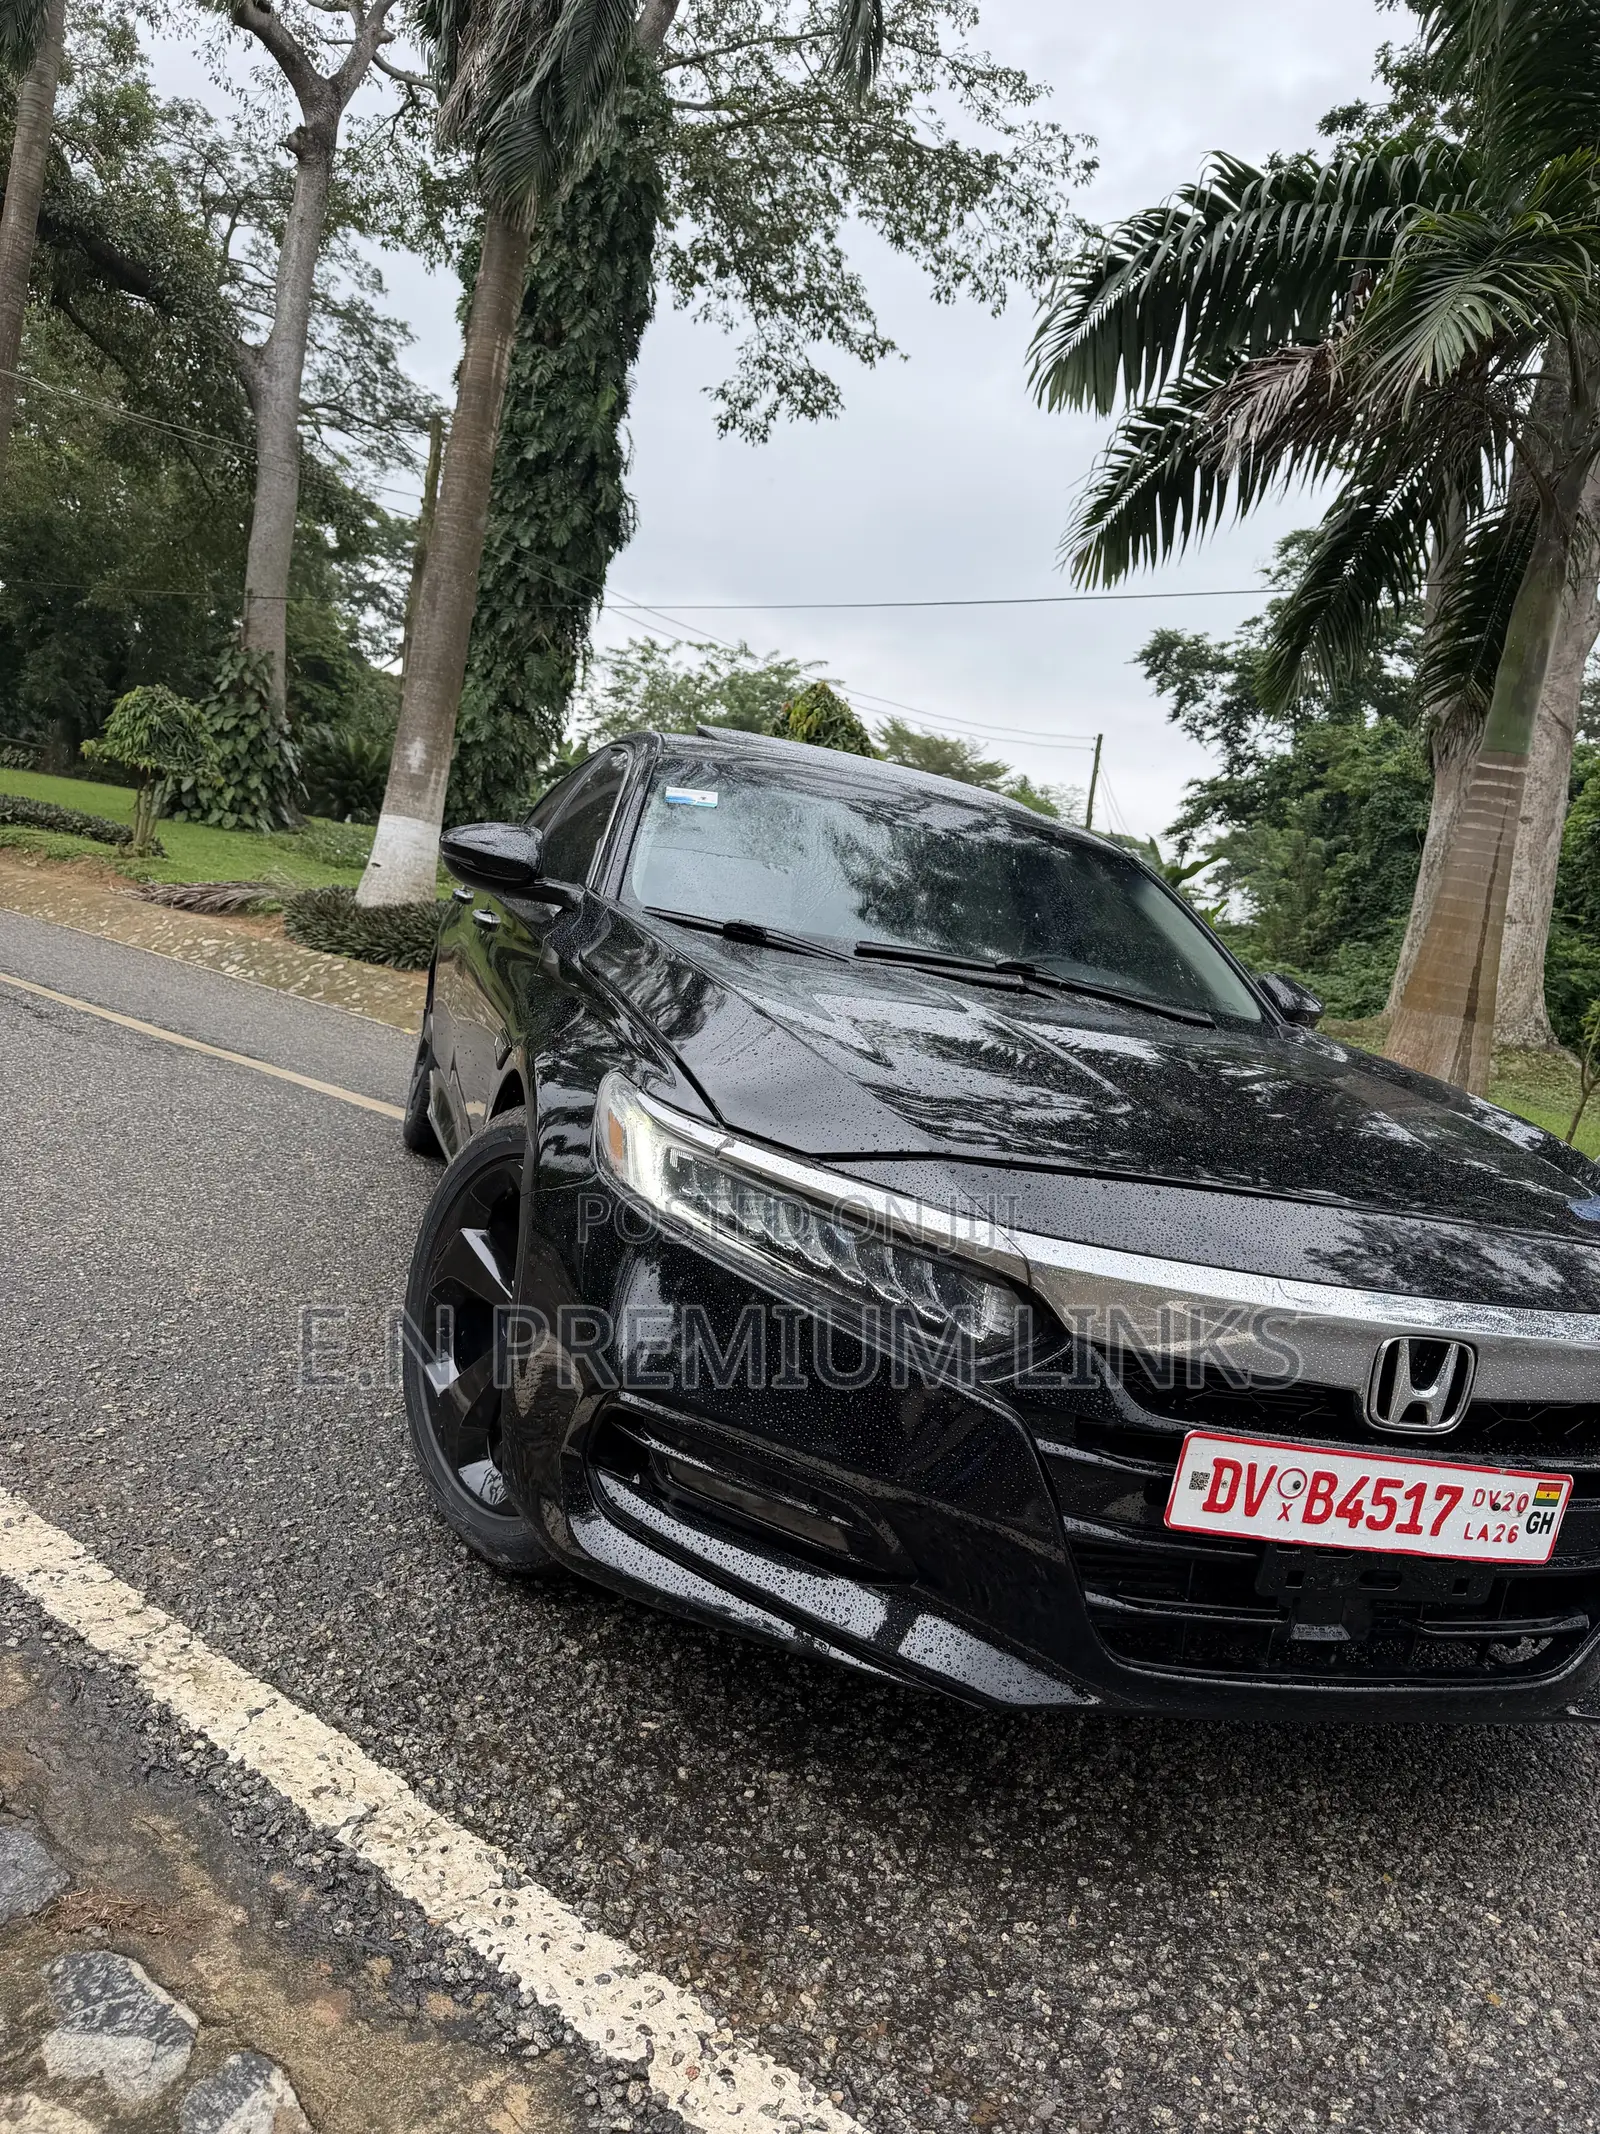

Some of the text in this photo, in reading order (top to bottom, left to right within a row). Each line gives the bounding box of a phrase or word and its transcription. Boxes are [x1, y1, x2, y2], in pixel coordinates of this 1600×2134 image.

[1201, 1456, 1464, 1536] DV B4517
[1463, 1522, 1520, 1544] LA26
[1525, 1511, 1556, 1535] GH
